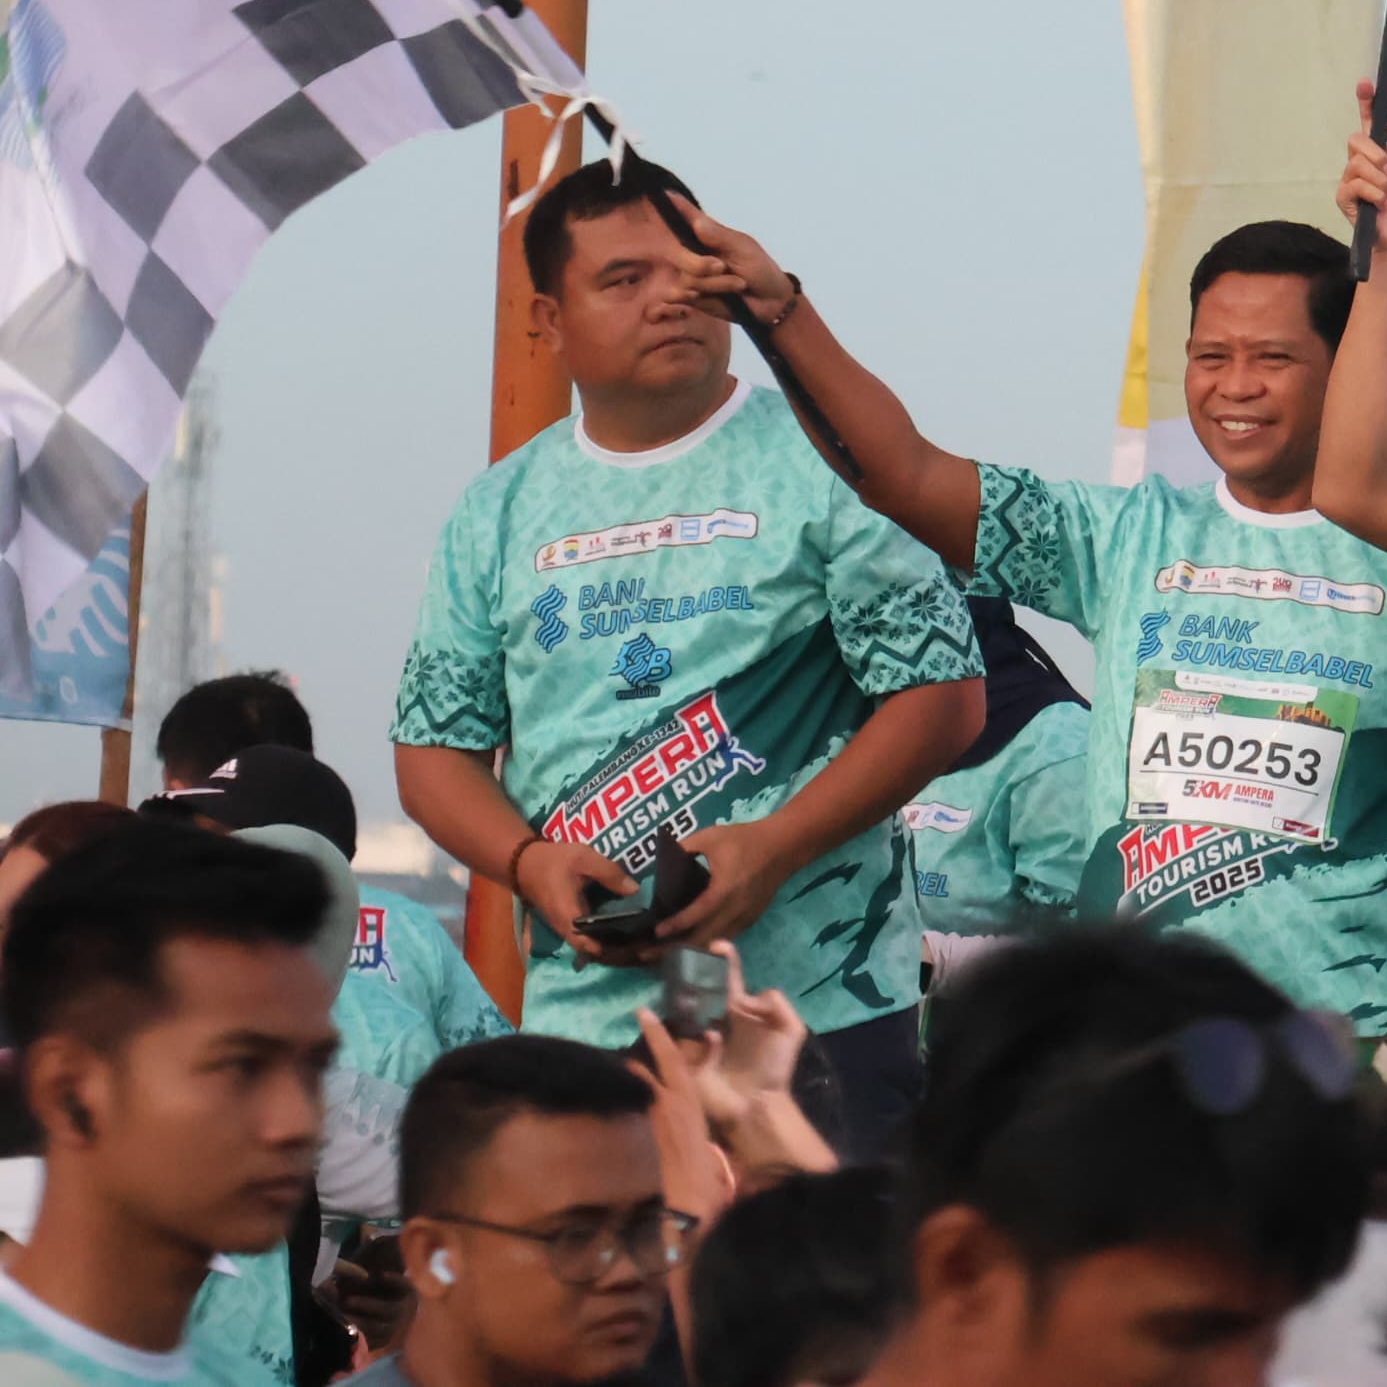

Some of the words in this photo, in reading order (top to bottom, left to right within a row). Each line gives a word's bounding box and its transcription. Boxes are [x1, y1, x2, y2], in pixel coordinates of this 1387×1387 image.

[1178, 614, 1260, 645] BANK
[1171, 639, 1374, 689] SUMSELBABEL
[672, 750, 725, 802] RUN
[1143, 731, 1322, 787] A50253
[1234, 784, 1275, 802] AMPERA
[1136, 835, 1244, 905] TOURISM
[1192, 857, 1263, 904] 2025
